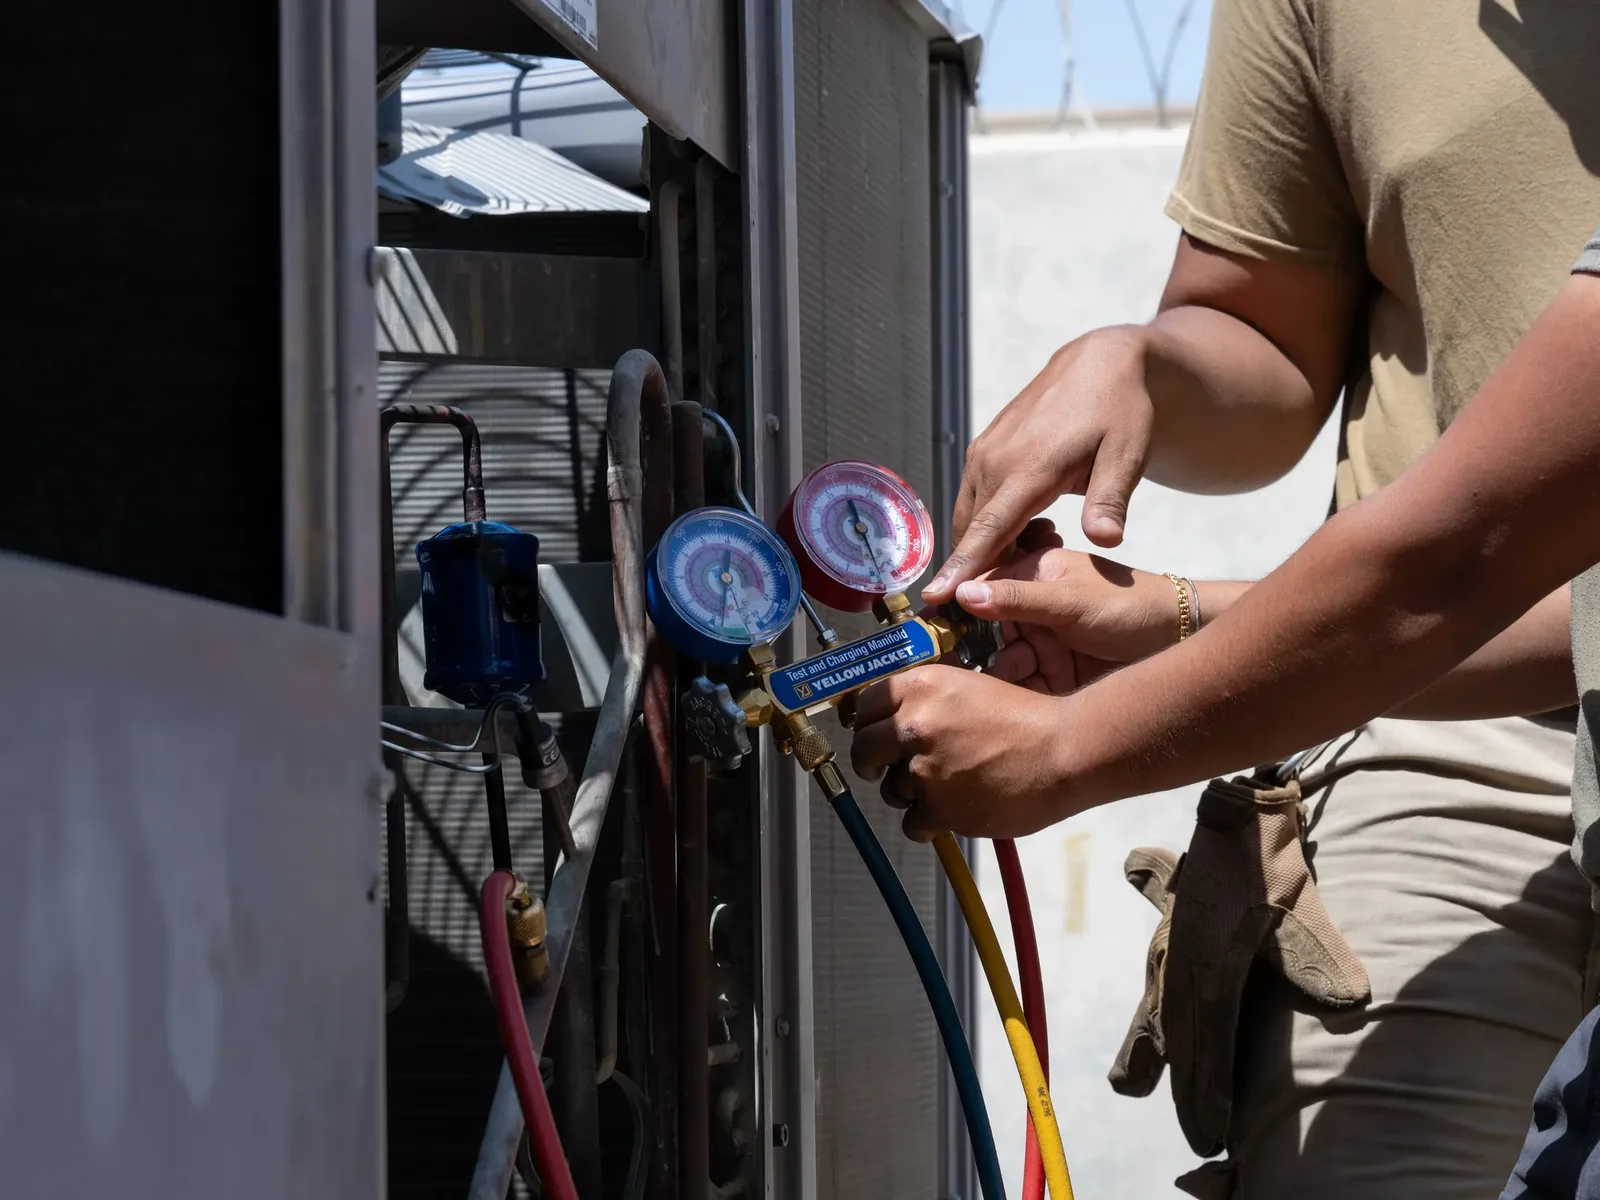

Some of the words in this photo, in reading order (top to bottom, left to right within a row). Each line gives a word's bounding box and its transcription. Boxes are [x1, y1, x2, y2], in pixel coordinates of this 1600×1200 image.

[862, 475, 878, 485] 500
[897, 499, 910, 513] 600
[707, 519, 724, 527] 200
[674, 528, 686, 539] 150
[746, 530, 762, 543] 250
[912, 538, 921, 554] 700
[775, 561, 787, 576] 300
[779, 599, 789, 612] 350
[786, 667, 807, 682] Test
[808, 659, 827, 674] and
[826, 645, 870, 668] Charging
[869, 628, 909, 651] Manifold
[811, 664, 866, 692] YELLOW
[867, 645, 913, 672] JACKET
